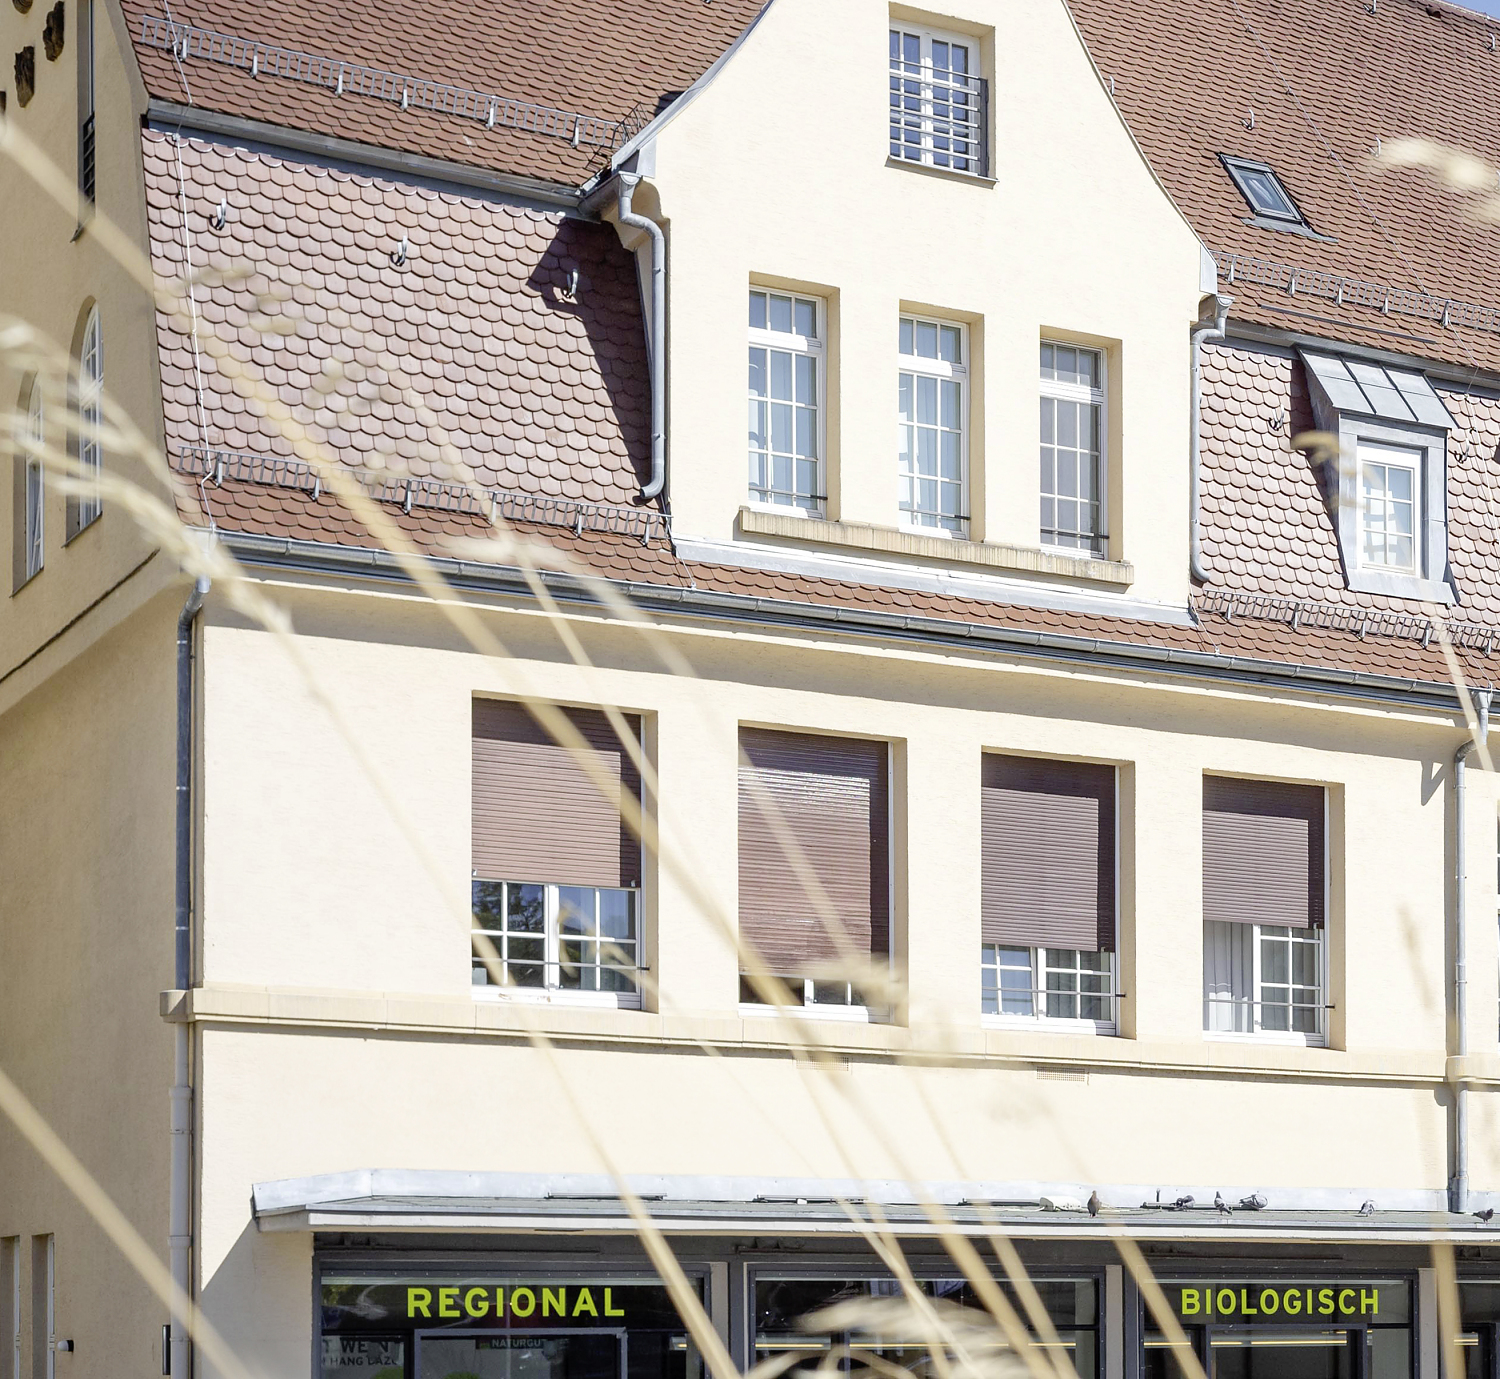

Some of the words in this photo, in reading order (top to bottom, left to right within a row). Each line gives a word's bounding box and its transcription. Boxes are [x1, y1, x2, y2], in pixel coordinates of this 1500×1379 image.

[407, 1286, 625, 1318] REGIONAL
[1181, 1288, 1379, 1315] BIOLOGISCH
[491, 1338, 547, 1348] NATURGU
